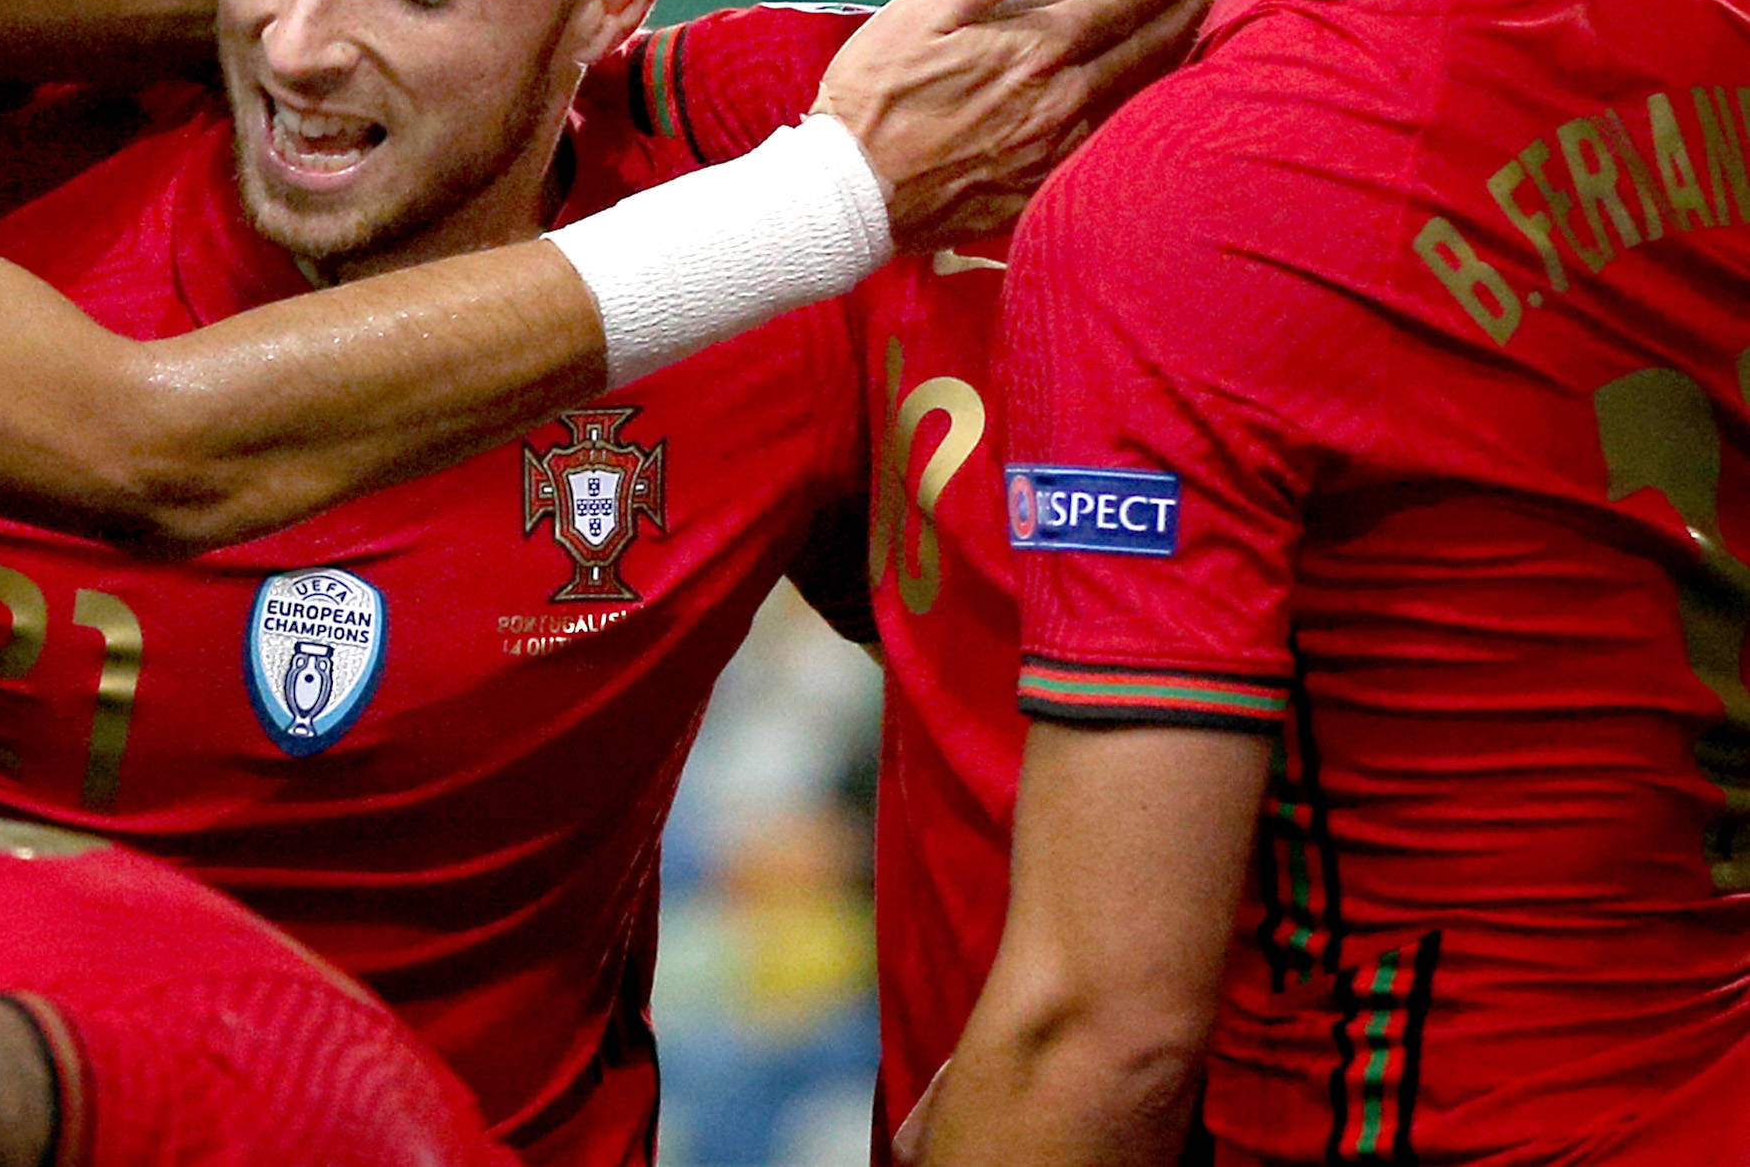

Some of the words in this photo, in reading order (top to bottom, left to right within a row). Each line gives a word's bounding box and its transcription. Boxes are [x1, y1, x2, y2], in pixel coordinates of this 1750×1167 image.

[295, 579, 348, 603] UEFA
[266, 599, 372, 628] EUROPEAN
[263, 617, 369, 644] CHAMPIONS
